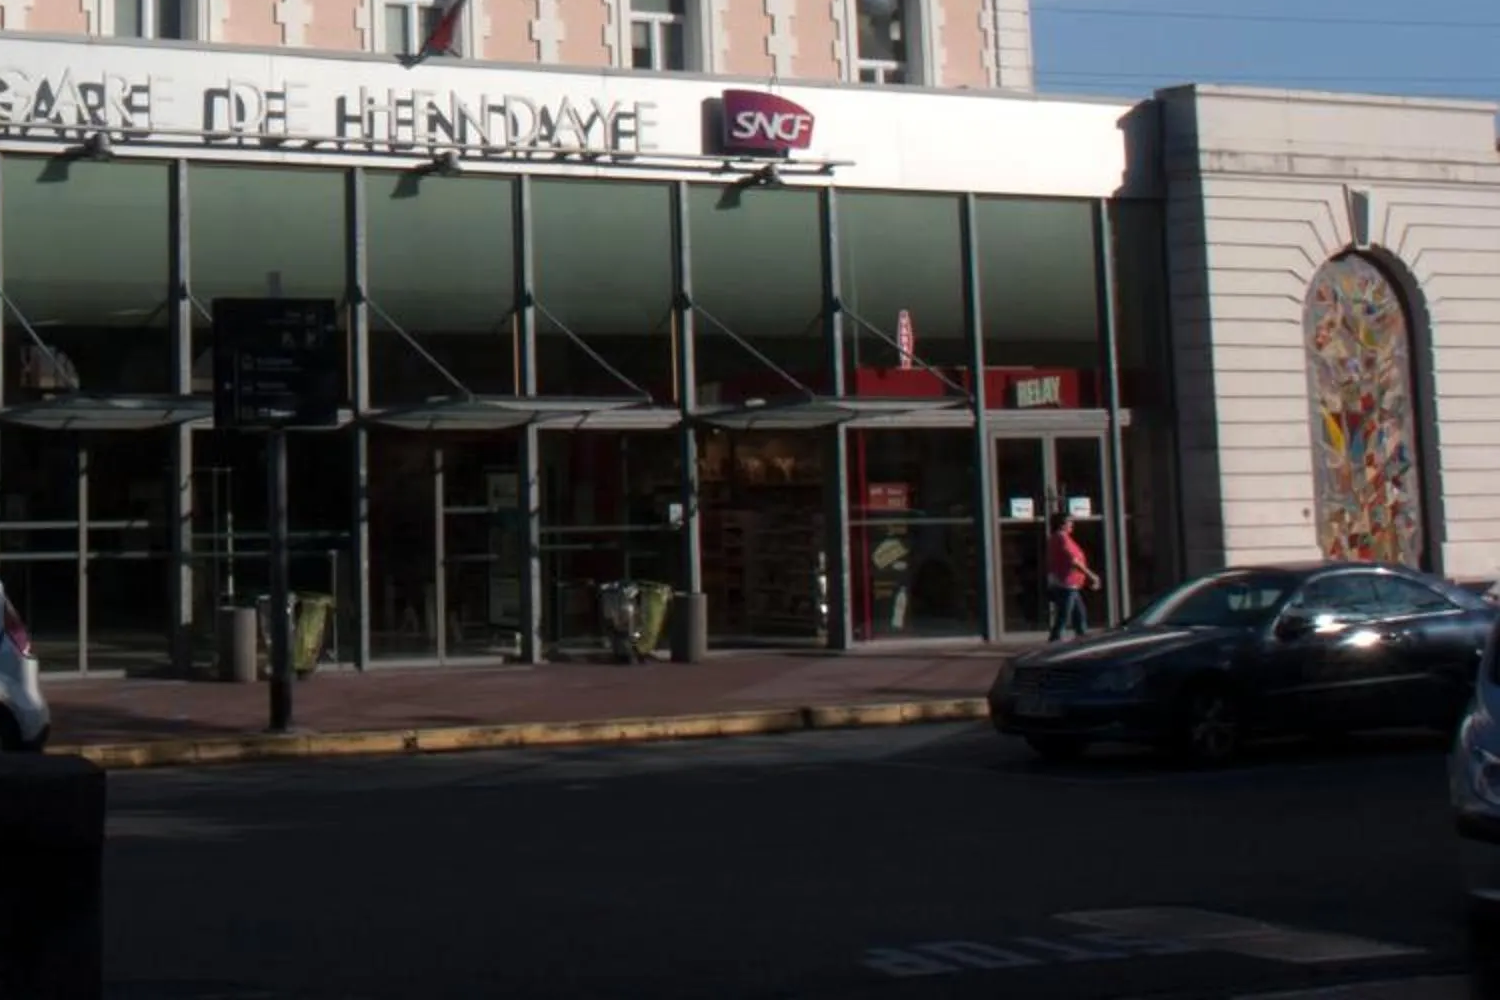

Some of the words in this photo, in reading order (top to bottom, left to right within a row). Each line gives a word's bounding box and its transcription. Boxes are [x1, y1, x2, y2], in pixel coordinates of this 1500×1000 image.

[227, 77, 311, 136] DE
[358, 85, 657, 152] HENDAYE
[731, 110, 812, 141] SNCF
[1016, 375, 1061, 408] RELAY
